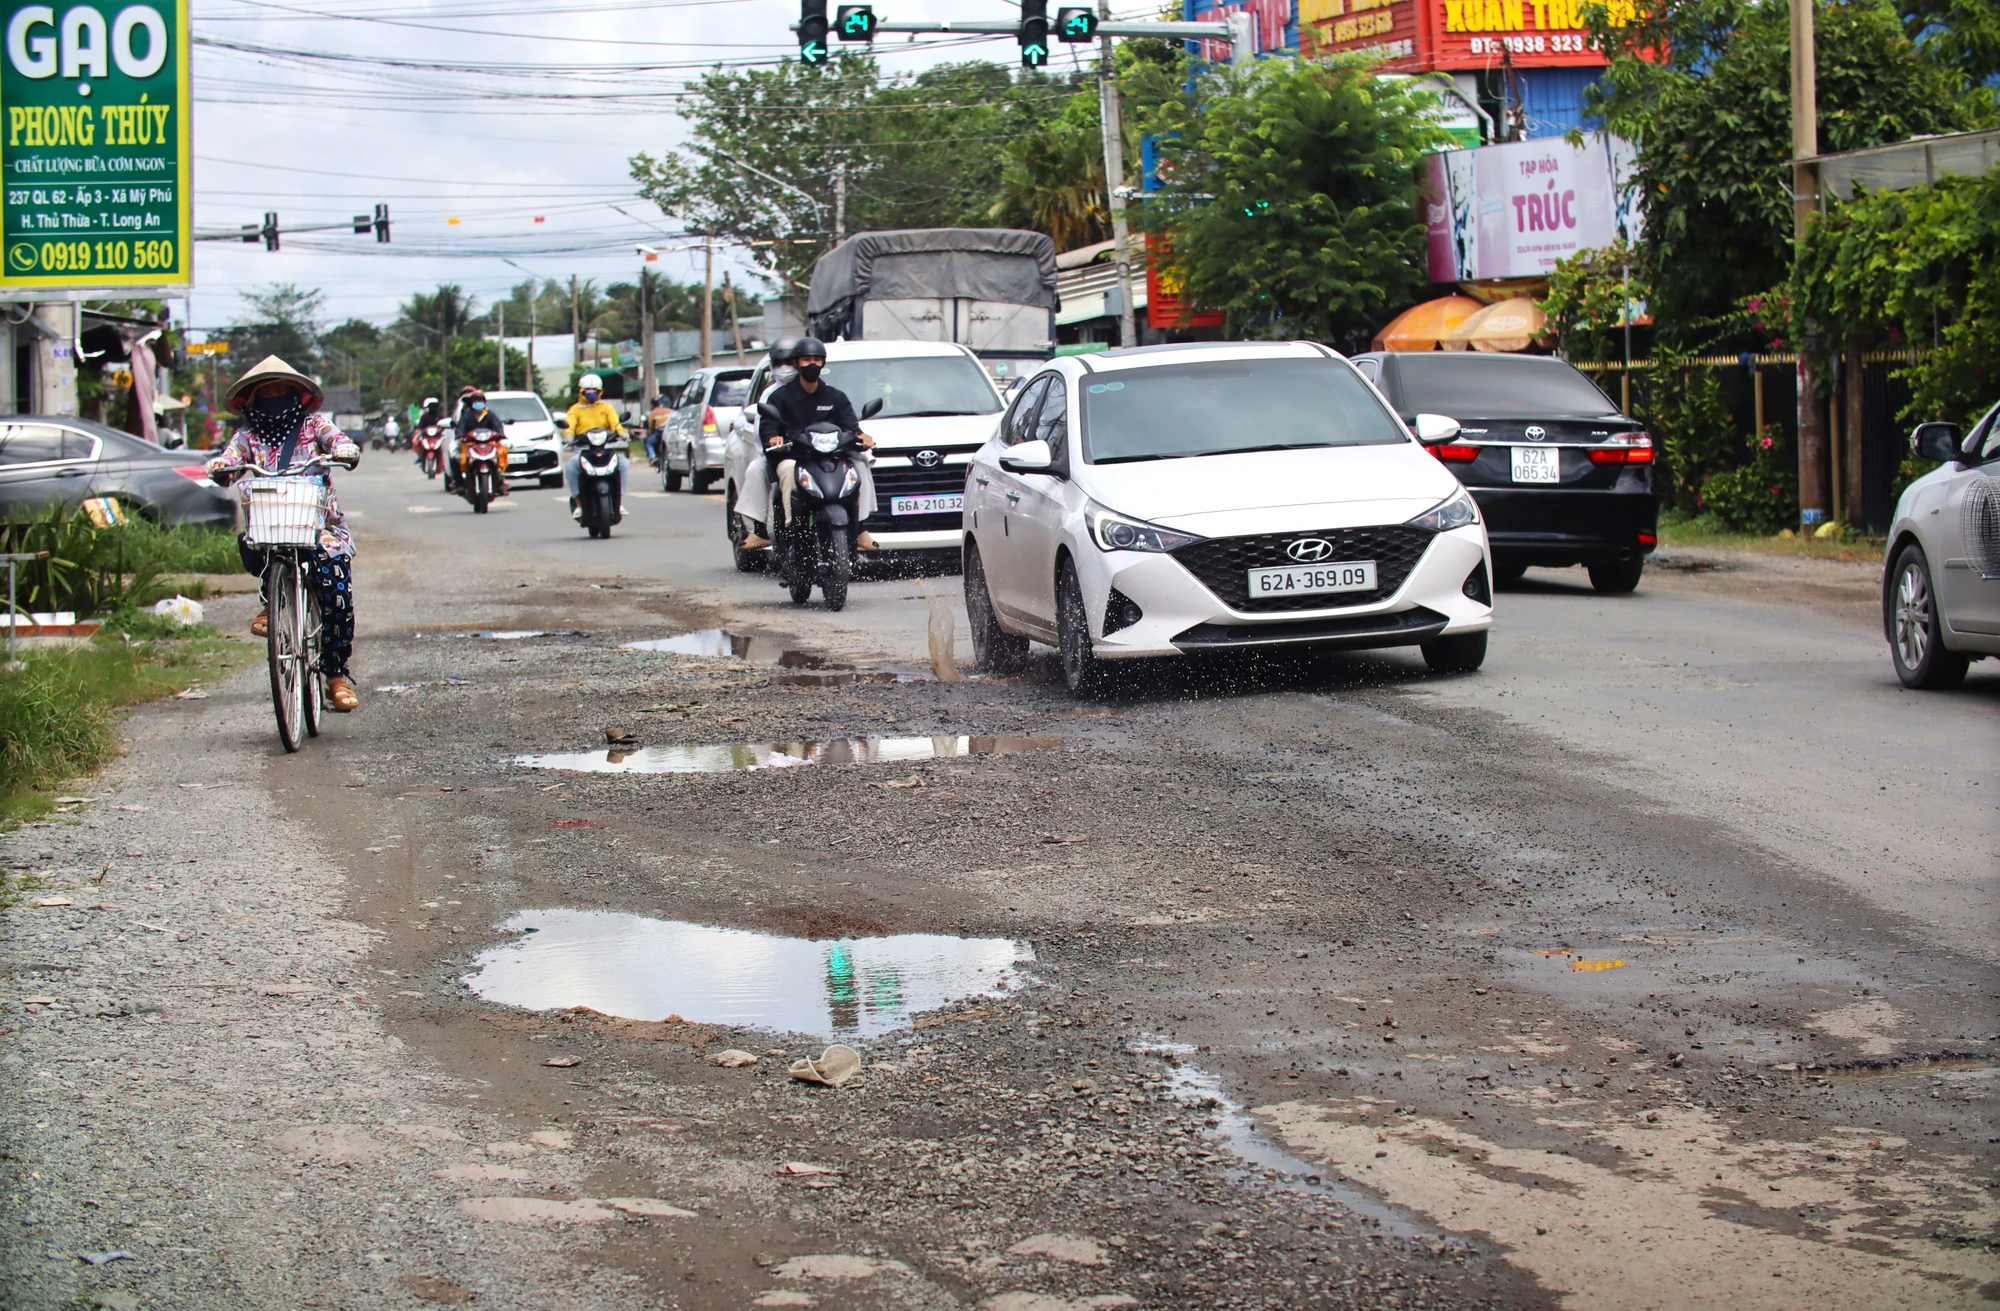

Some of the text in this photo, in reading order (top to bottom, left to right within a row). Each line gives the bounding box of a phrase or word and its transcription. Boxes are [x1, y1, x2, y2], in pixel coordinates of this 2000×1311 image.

[846, 14, 868, 32] 24
[7, 5, 169, 97] GẠO
[1551, 35, 1583, 52] 323
[9, 93, 170, 146] PHONG THÚY
[15, 155, 44, 173] CHẤT
[45, 157, 82, 175] LƯỢNG
[107, 157, 133, 172] CƠM
[135, 157, 165, 171] NGON
[1519, 154, 1558, 178] TẠP HÓA
[9, 191, 30, 205] 237
[32, 190, 50, 204] QL
[52, 190, 66, 203] 62
[76, 186, 92, 207] Ấp
[94, 190, 102, 203] 3
[112, 189, 127, 203] Xã
[129, 189, 147, 206] Mỹ
[149, 187, 172, 203] Phú
[1512, 178, 1576, 233] TRÚC
[21, 214, 35, 229] H.
[36, 212, 59, 228] Thủ
[61, 213, 91, 228] Thừa
[100, 213, 110, 227] T.
[113, 213, 141, 230] Long
[144, 212, 160, 227] An
[41, 240, 173, 270] 0919 110 560
[1523, 450, 1547, 464] 62A
[1514, 466, 1557, 480] 065.34
[897, 498, 963, 511] 66A-210.32
[1261, 568, 1365, 591] 62A-369.09
